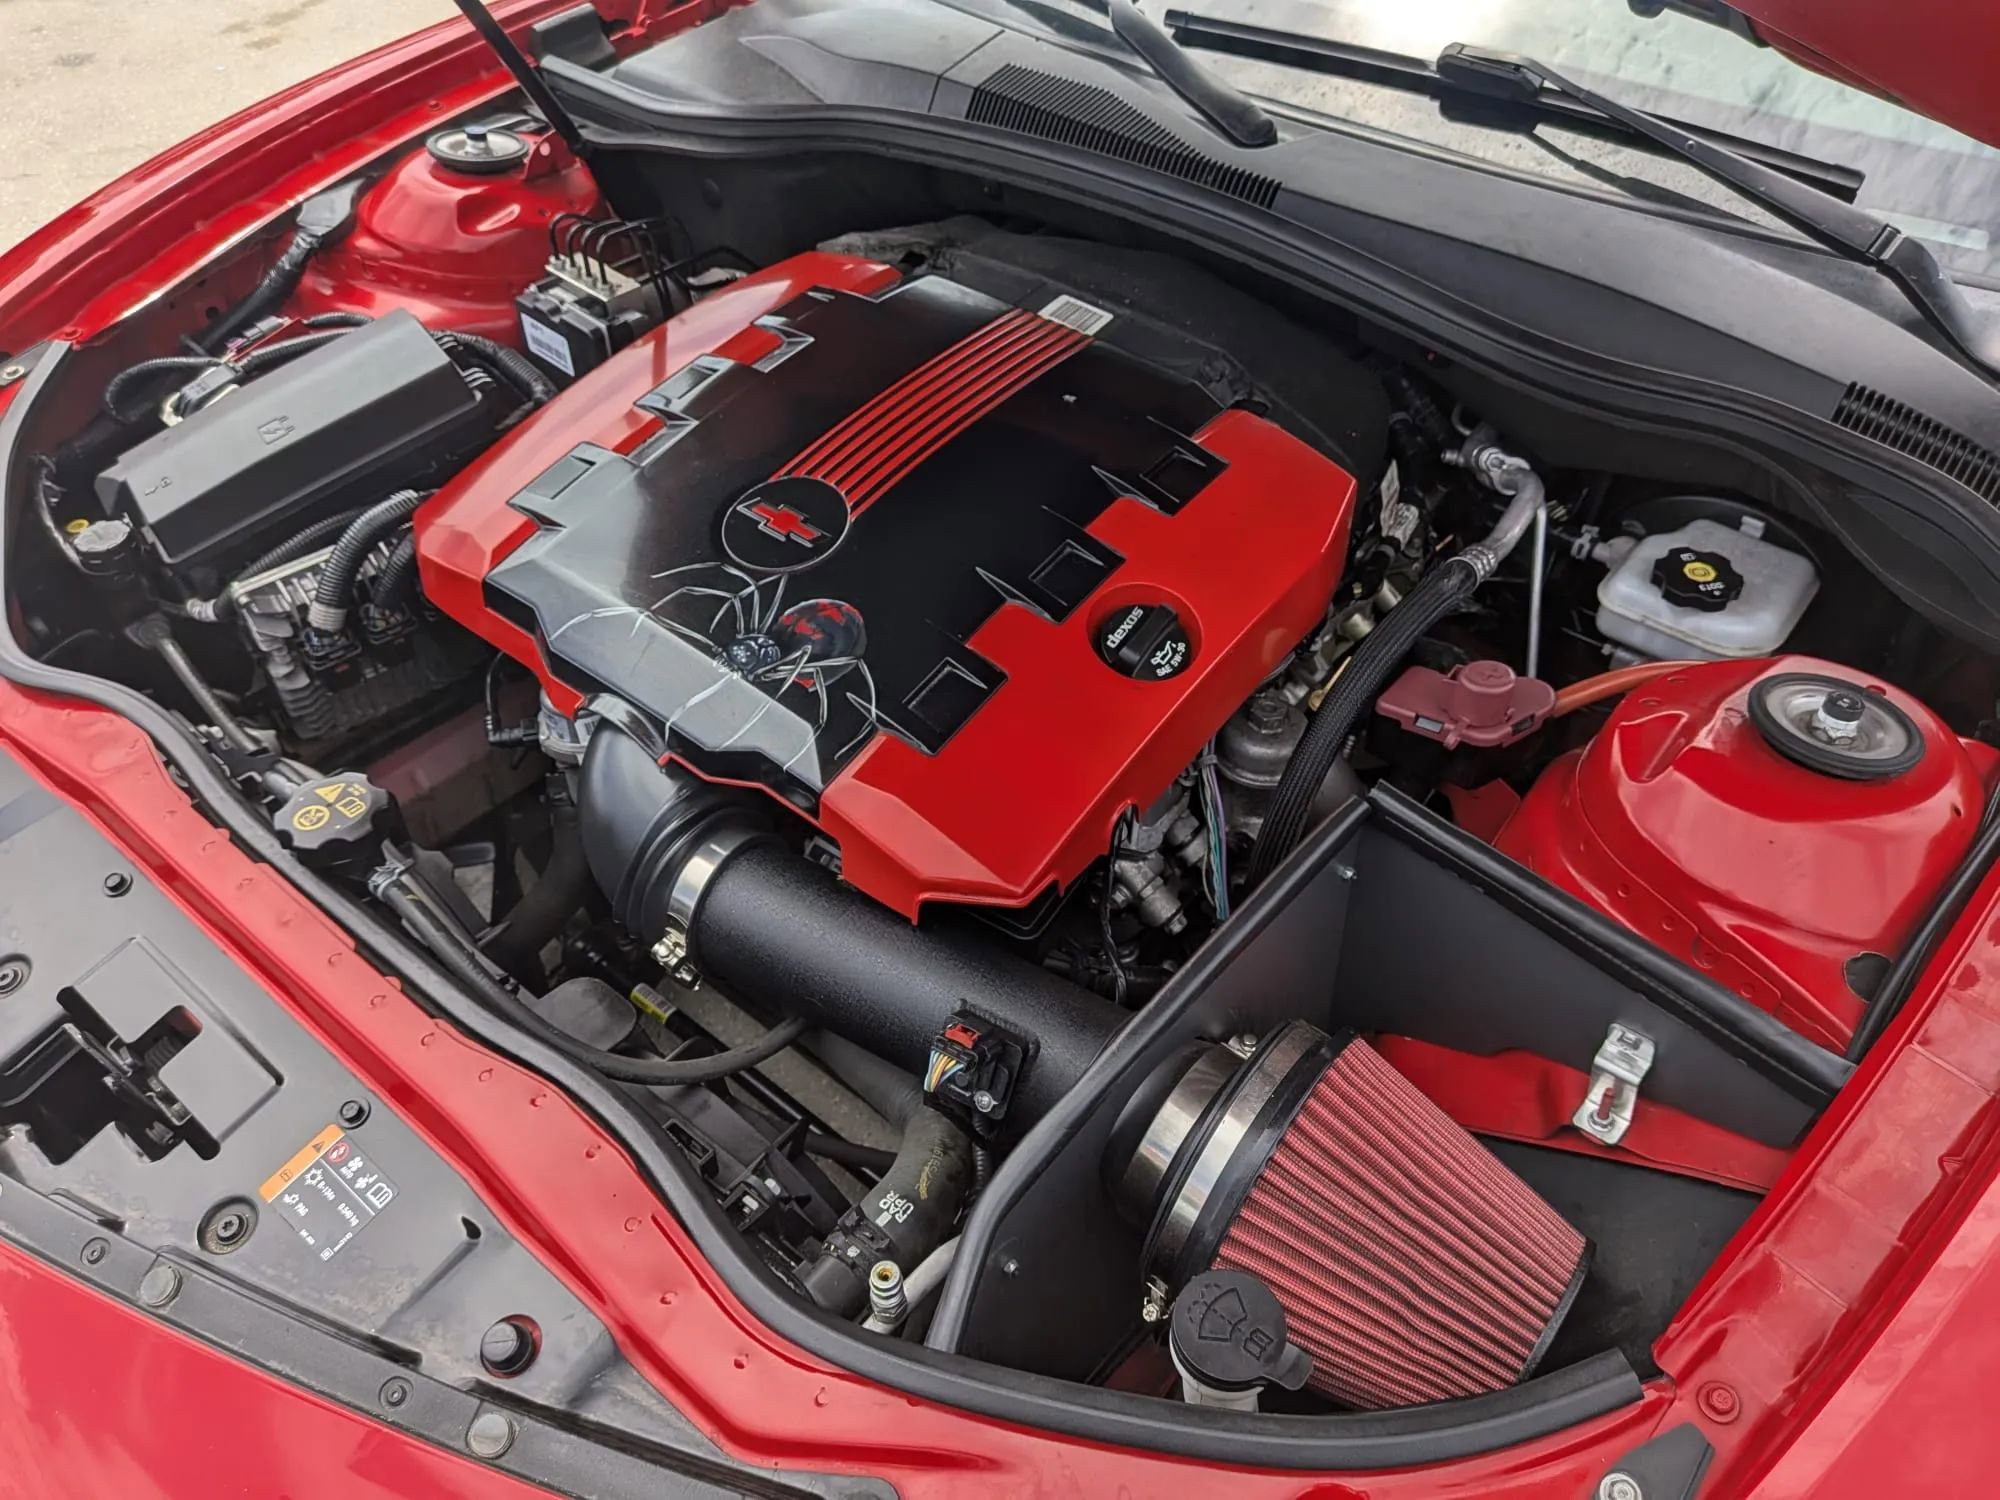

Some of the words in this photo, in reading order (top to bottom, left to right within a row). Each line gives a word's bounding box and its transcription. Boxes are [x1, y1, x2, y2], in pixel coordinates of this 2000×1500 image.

[1106, 606, 1144, 649] dexos
[1156, 664, 1173, 677] SAE
[1171, 642, 1186, 667] 5W-30
[879, 1199, 907, 1224] RAD
[886, 1190, 914, 1214] UPR
